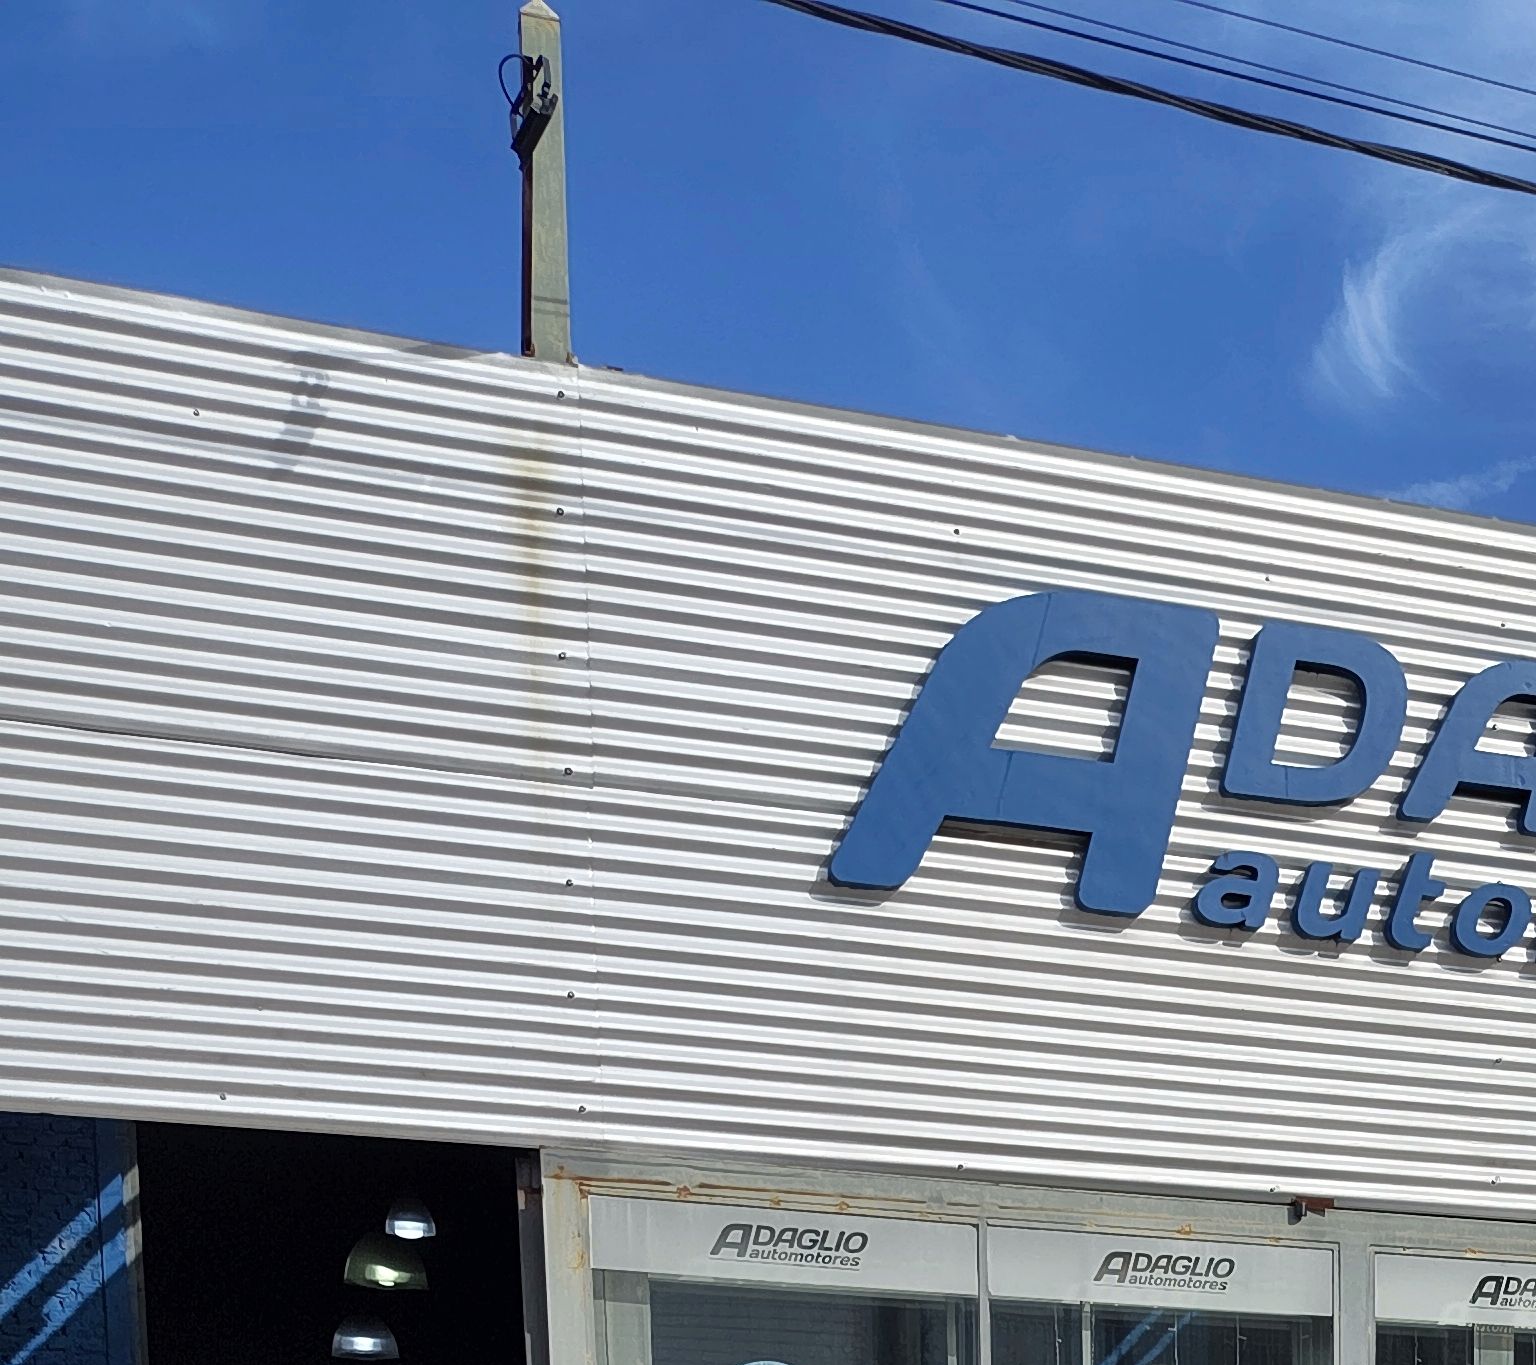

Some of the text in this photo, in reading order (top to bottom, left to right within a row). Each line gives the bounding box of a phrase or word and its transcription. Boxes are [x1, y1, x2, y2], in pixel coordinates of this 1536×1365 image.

[709, 1223, 869, 1257] ADAGLIO
[749, 1248, 861, 1267] automotores
[1093, 1251, 1236, 1283] ADAGLIO
[1128, 1274, 1229, 1291] automotores
